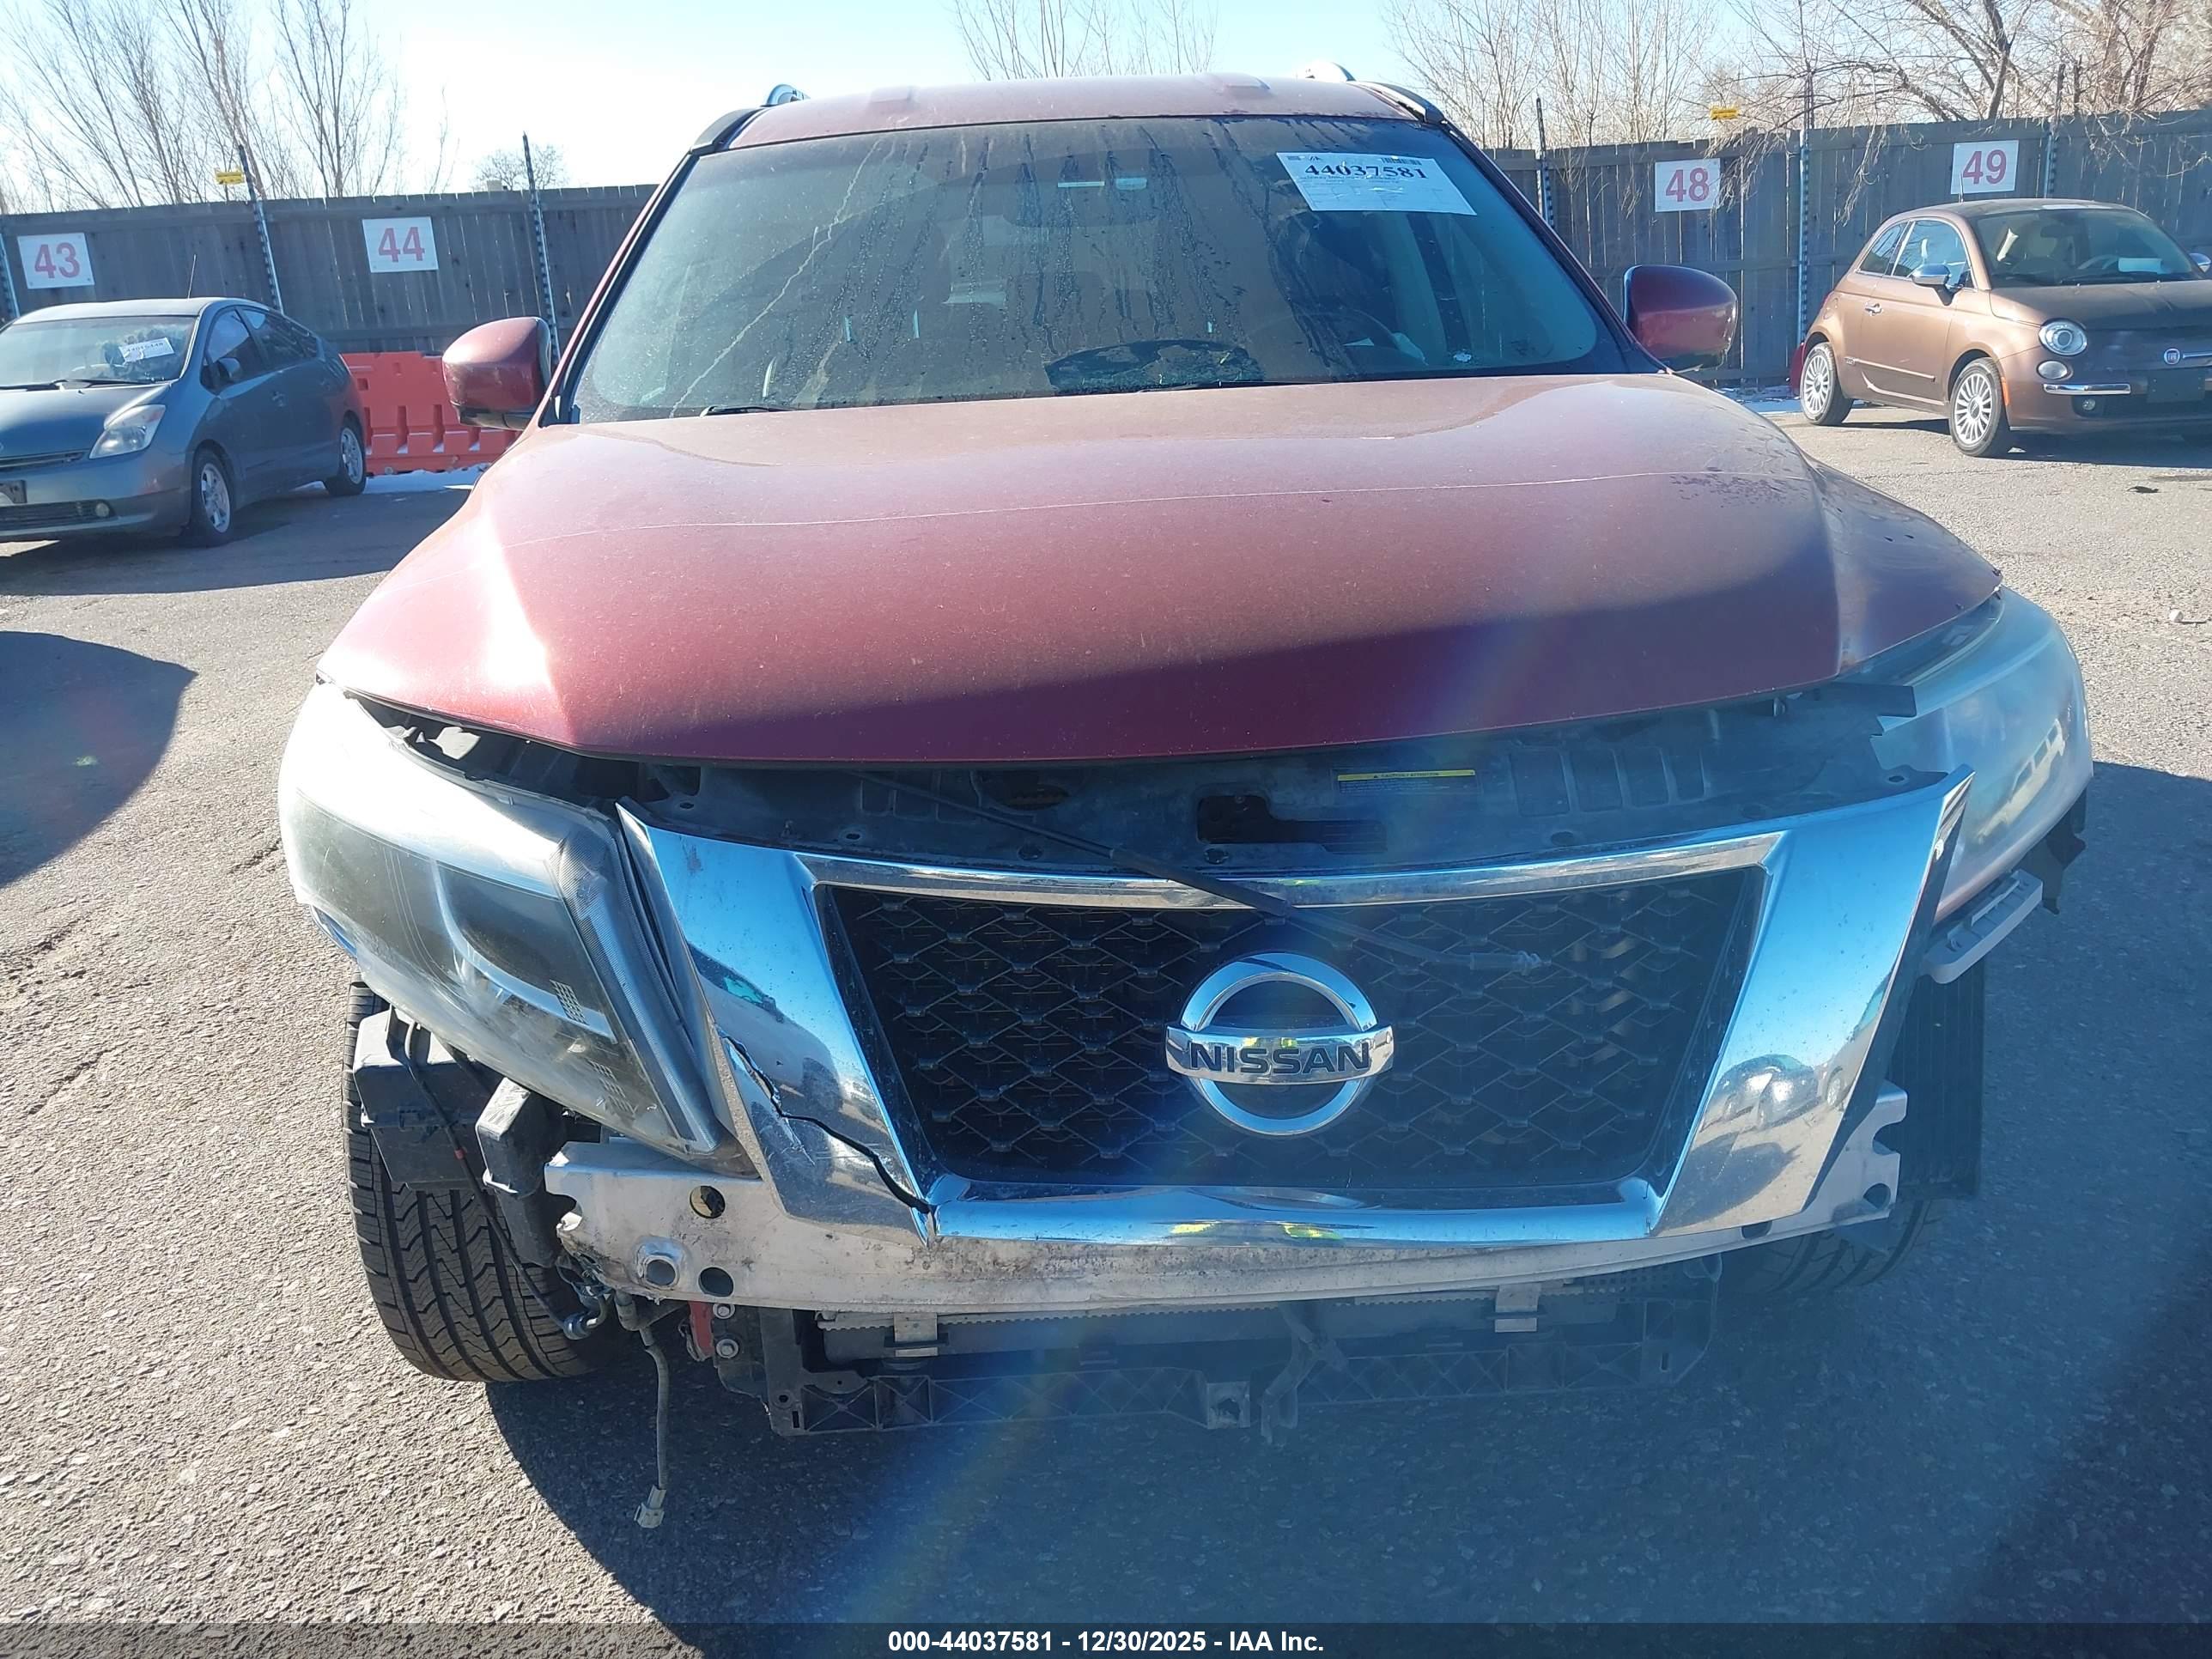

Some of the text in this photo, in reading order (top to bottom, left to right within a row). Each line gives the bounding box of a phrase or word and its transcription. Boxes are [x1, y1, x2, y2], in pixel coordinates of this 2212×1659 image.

[1304, 164, 1429, 179] 44037581
[1665, 167, 1709, 202] 48
[1962, 149, 2007, 185] 49
[34, 242, 80, 279] 43
[378, 227, 426, 263] 44
[1189, 1041, 1371, 1074] NISSAN
